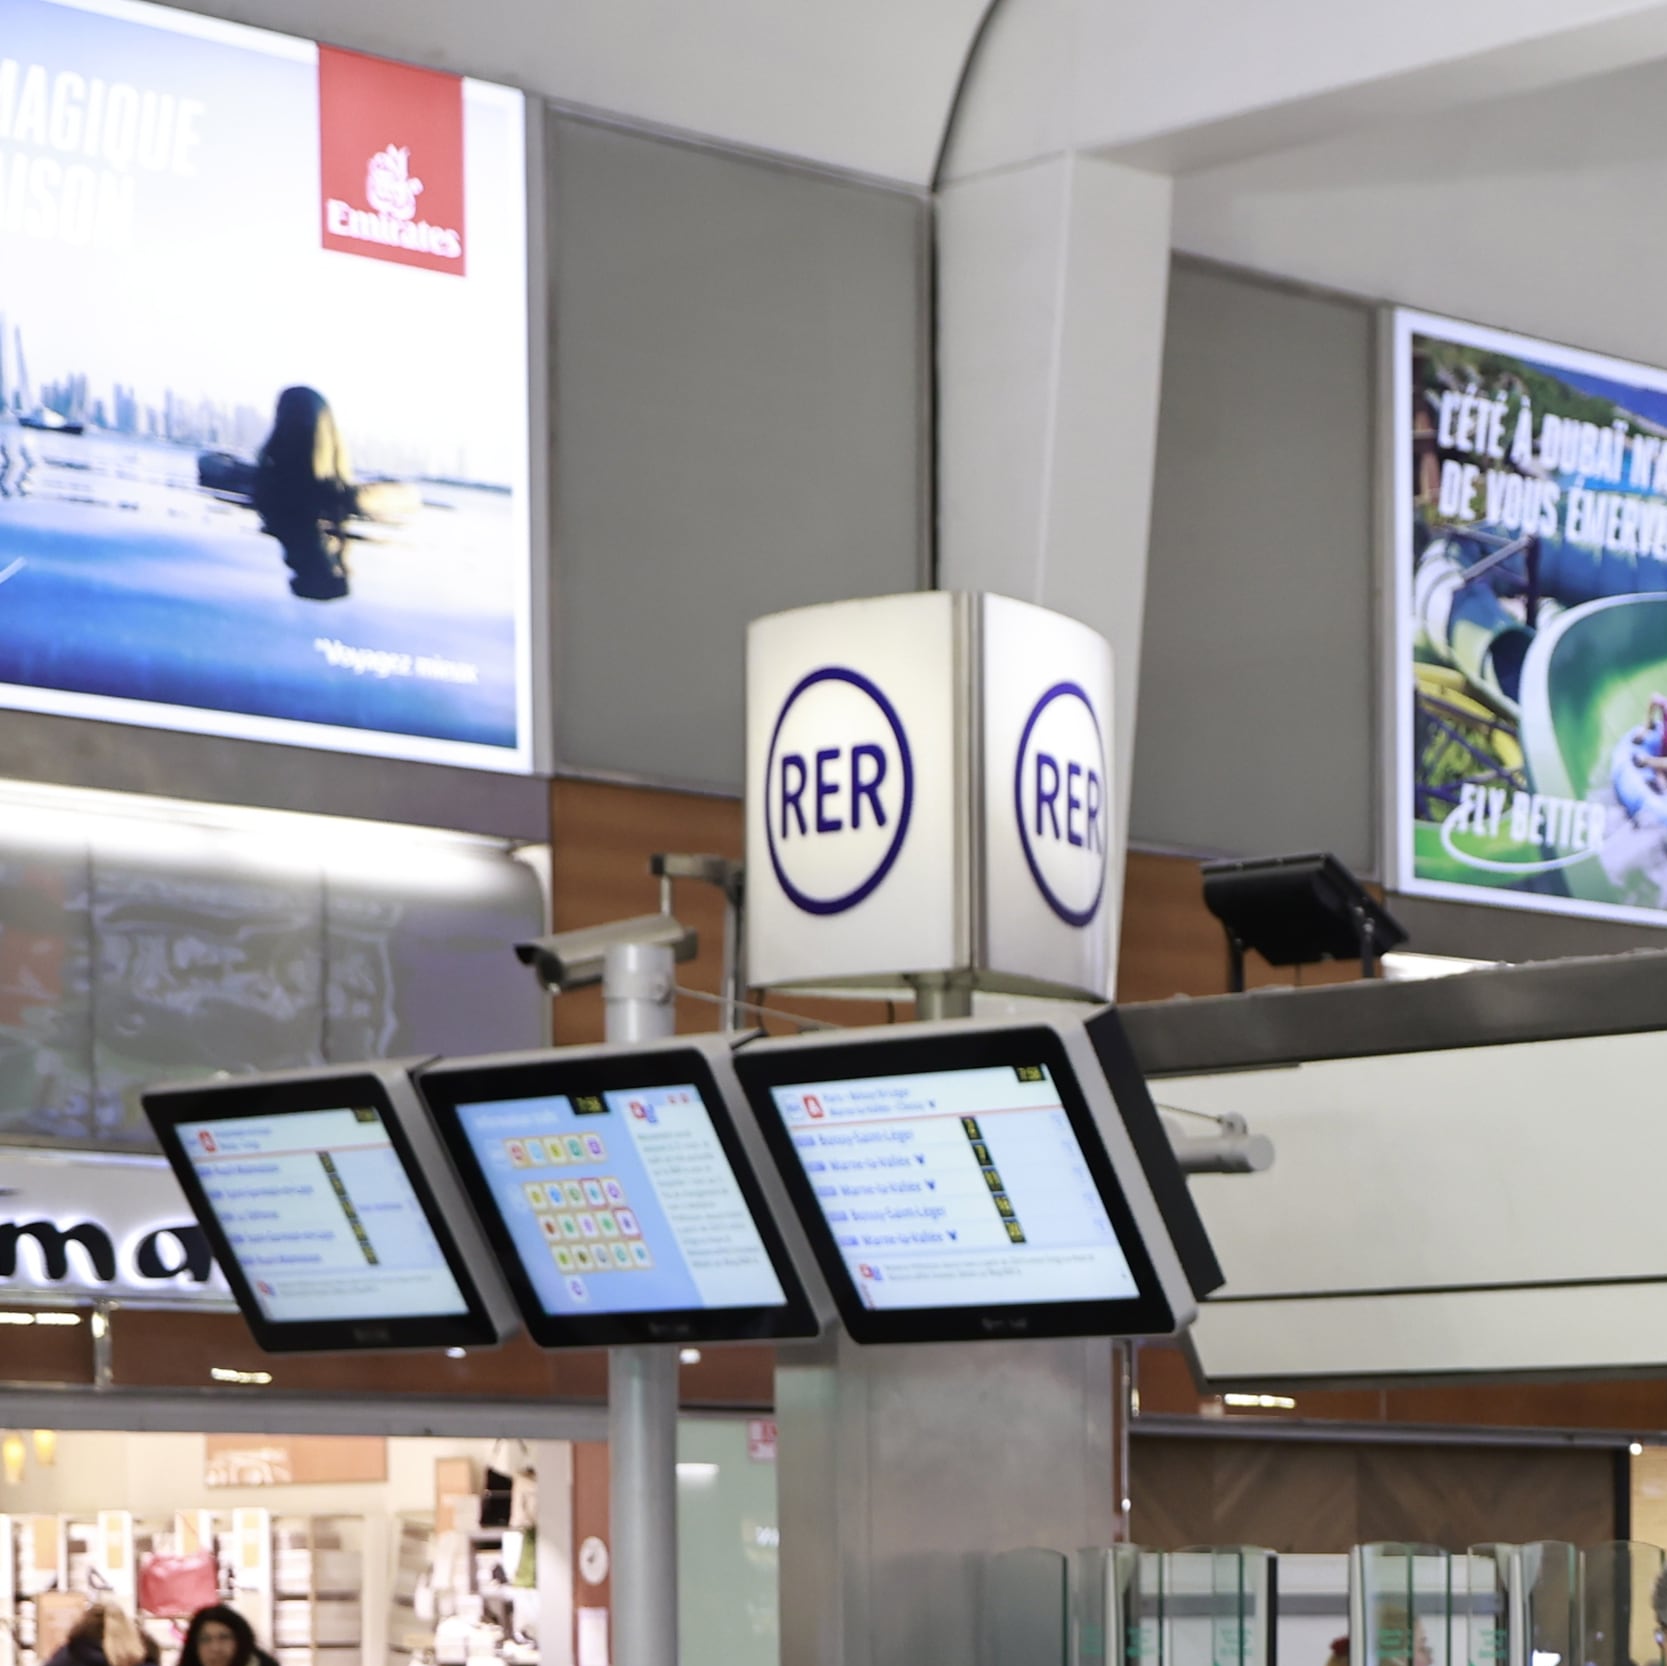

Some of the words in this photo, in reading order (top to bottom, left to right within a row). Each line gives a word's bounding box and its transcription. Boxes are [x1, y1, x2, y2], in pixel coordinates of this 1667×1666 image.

[326, 198, 461, 258] Emirates
[1540, 412, 1629, 482] DUBAÏ
[1438, 460, 1478, 519] DE
[1484, 469, 1560, 537] VOUS
[782, 743, 887, 839] RER
[1035, 751, 1101, 856] RER
[1452, 782, 1506, 837] FLY
[1510, 790, 1606, 851] BETTER
